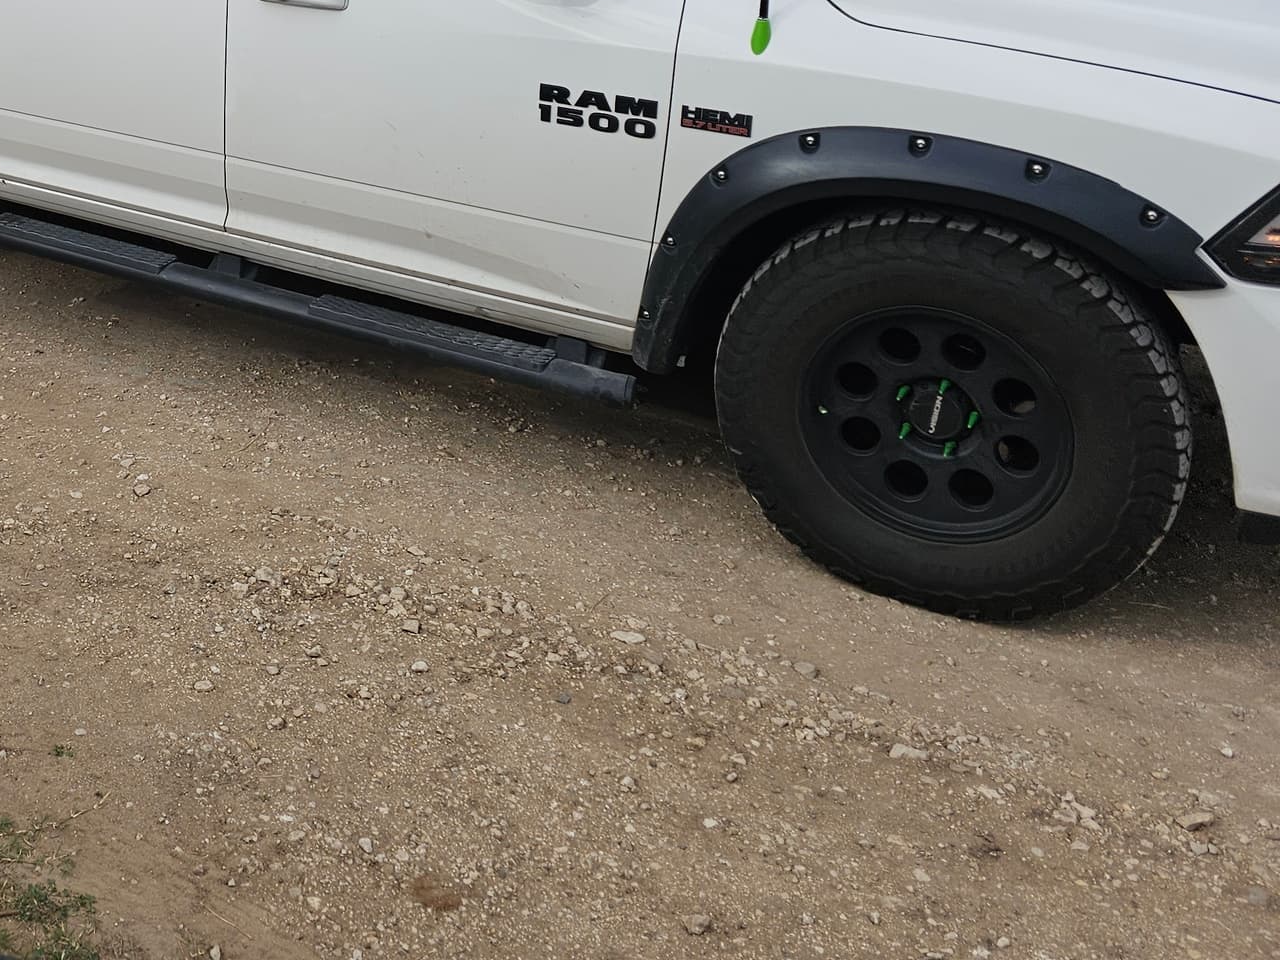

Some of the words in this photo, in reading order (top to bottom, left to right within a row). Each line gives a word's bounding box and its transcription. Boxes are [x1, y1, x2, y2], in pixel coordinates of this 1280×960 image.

[538, 82, 659, 120] RAM
[681, 104, 753, 128] HEMI
[538, 103, 657, 139] 1500
[681, 118, 706, 129] 5.7
[706, 122, 749, 136] LITER
